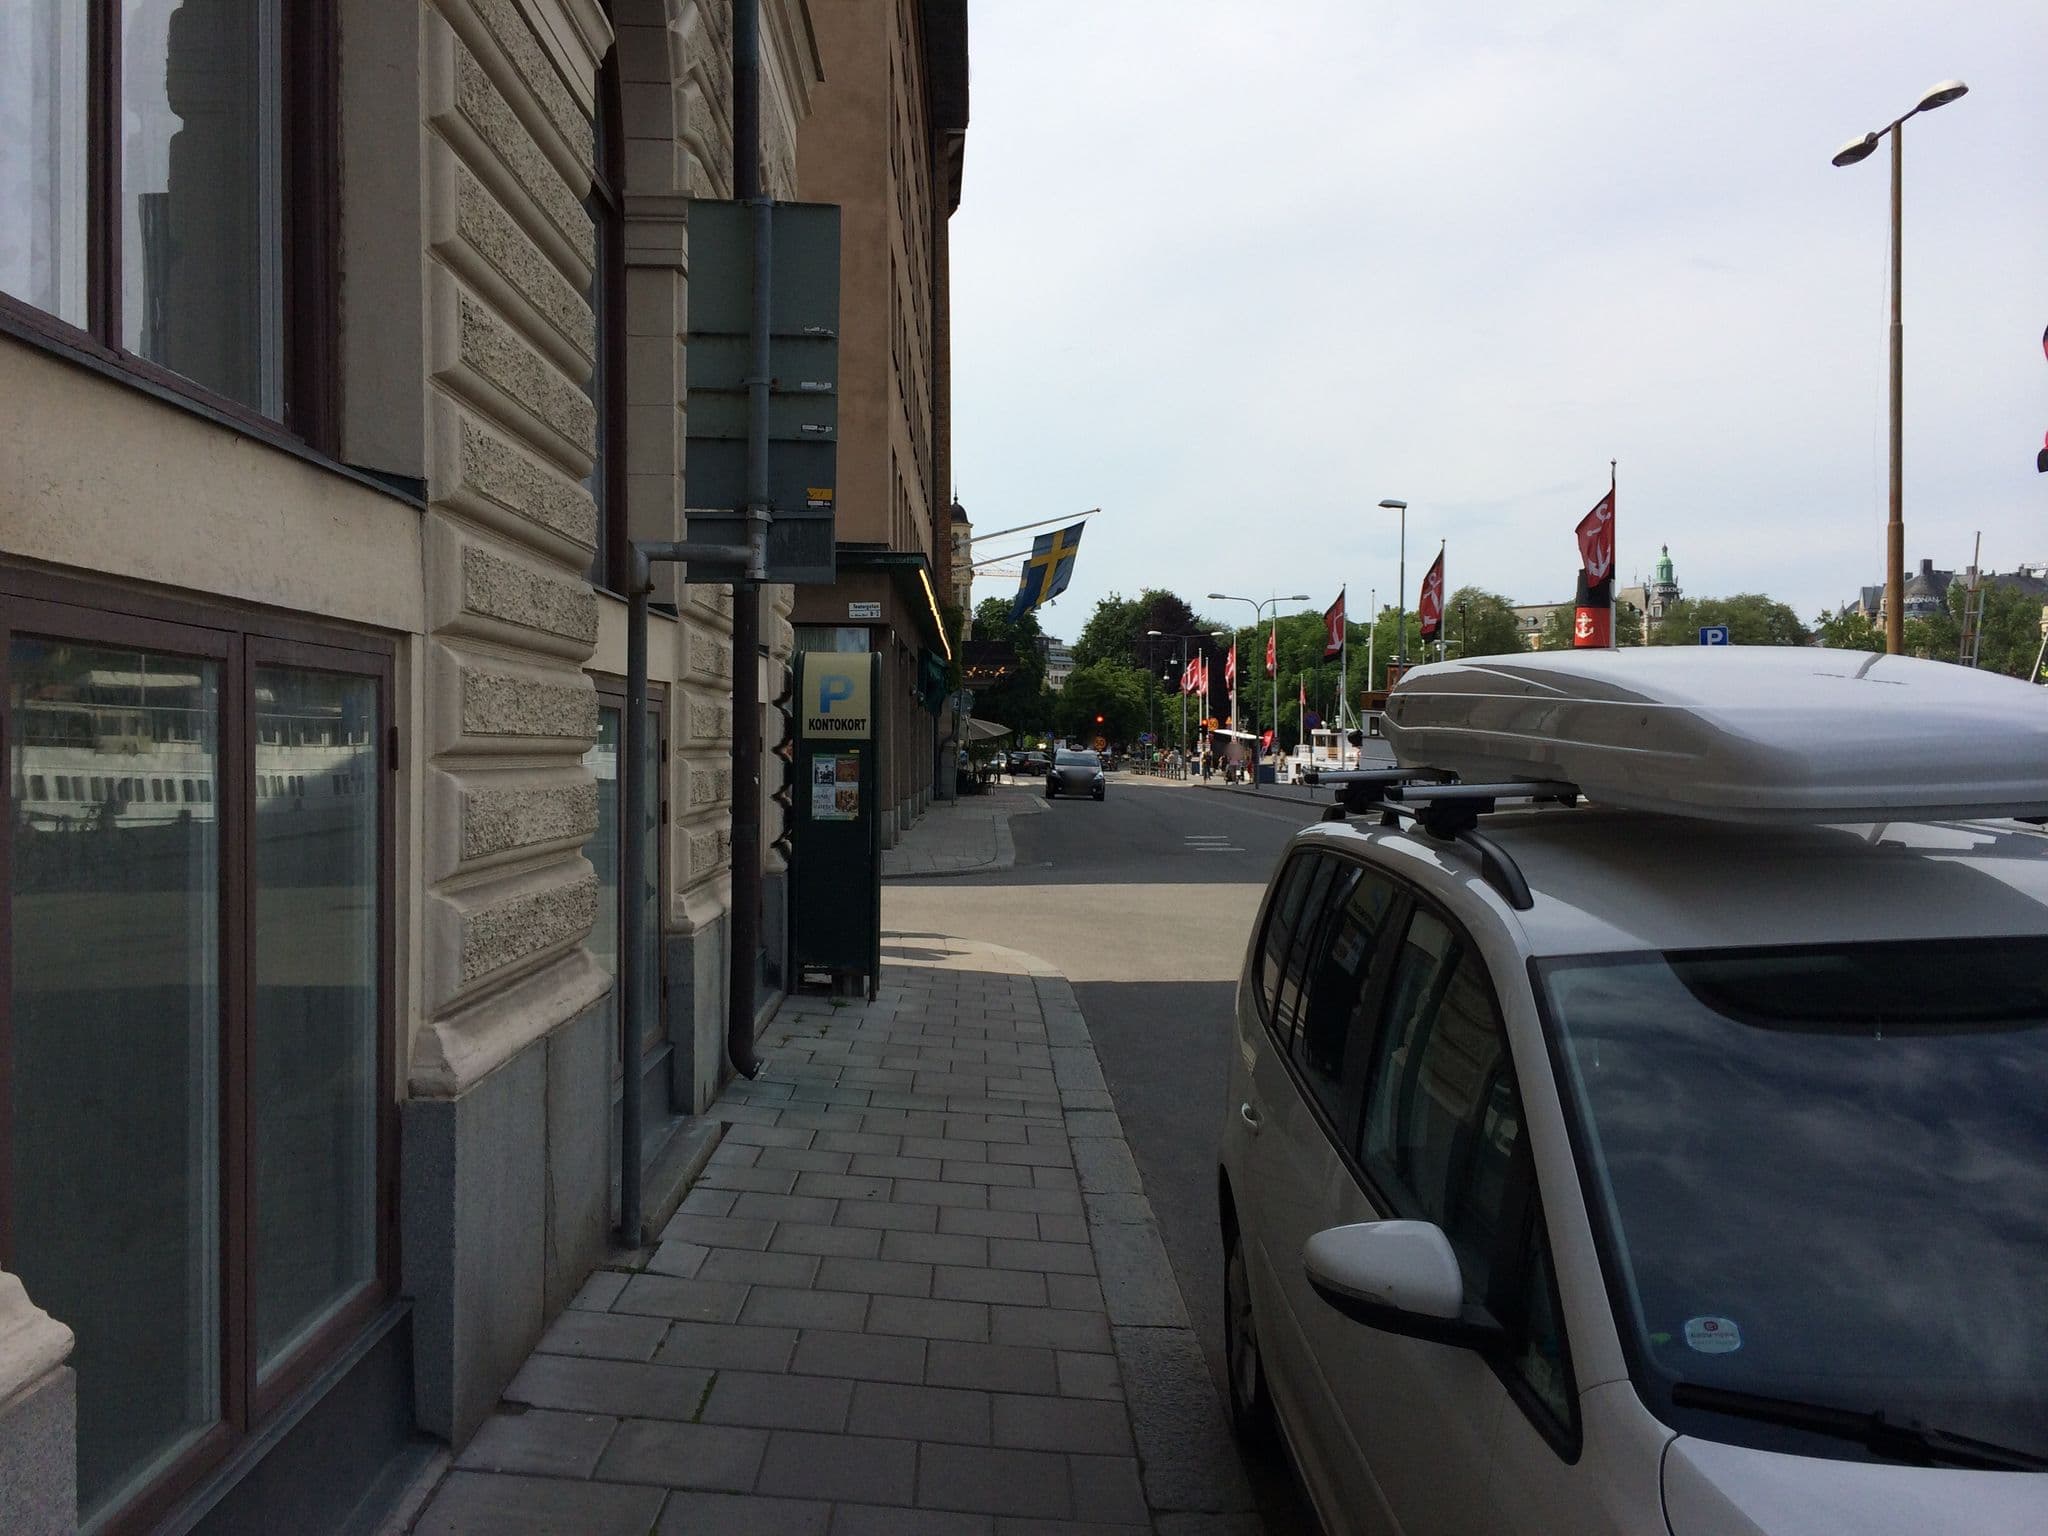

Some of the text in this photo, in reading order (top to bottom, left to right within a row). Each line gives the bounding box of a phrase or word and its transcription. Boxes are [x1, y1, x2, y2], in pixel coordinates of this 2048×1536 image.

[1707, 629, 1723, 646] P
[820, 674, 854, 713] P
[808, 718, 867, 731] KONTOKORT
